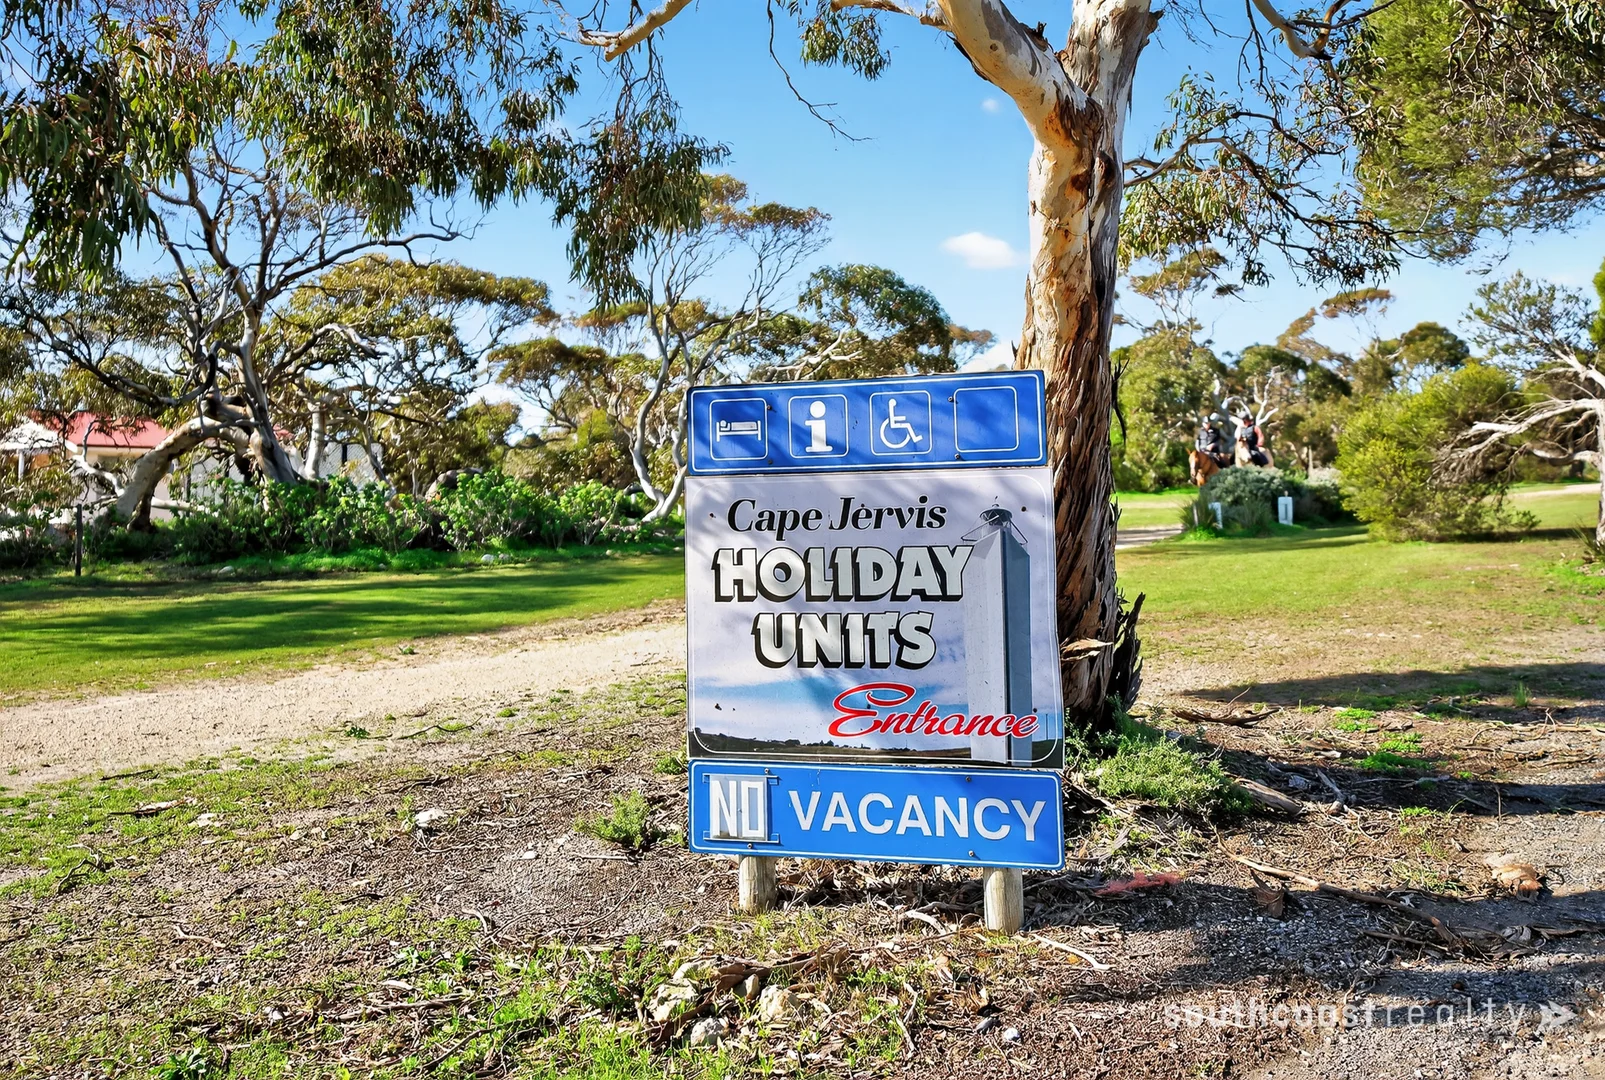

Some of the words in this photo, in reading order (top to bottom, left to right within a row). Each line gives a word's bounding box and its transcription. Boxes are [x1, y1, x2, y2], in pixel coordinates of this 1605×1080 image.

[728, 499, 822, 541] Cape
[829, 495, 947, 531] Jervis
[711, 545, 974, 602] HOLIDAY
[752, 611, 936, 669] UNITS
[828, 683, 1039, 737] Entrance
[712, 780, 765, 839] NO
[788, 790, 1047, 841] VACANCY
